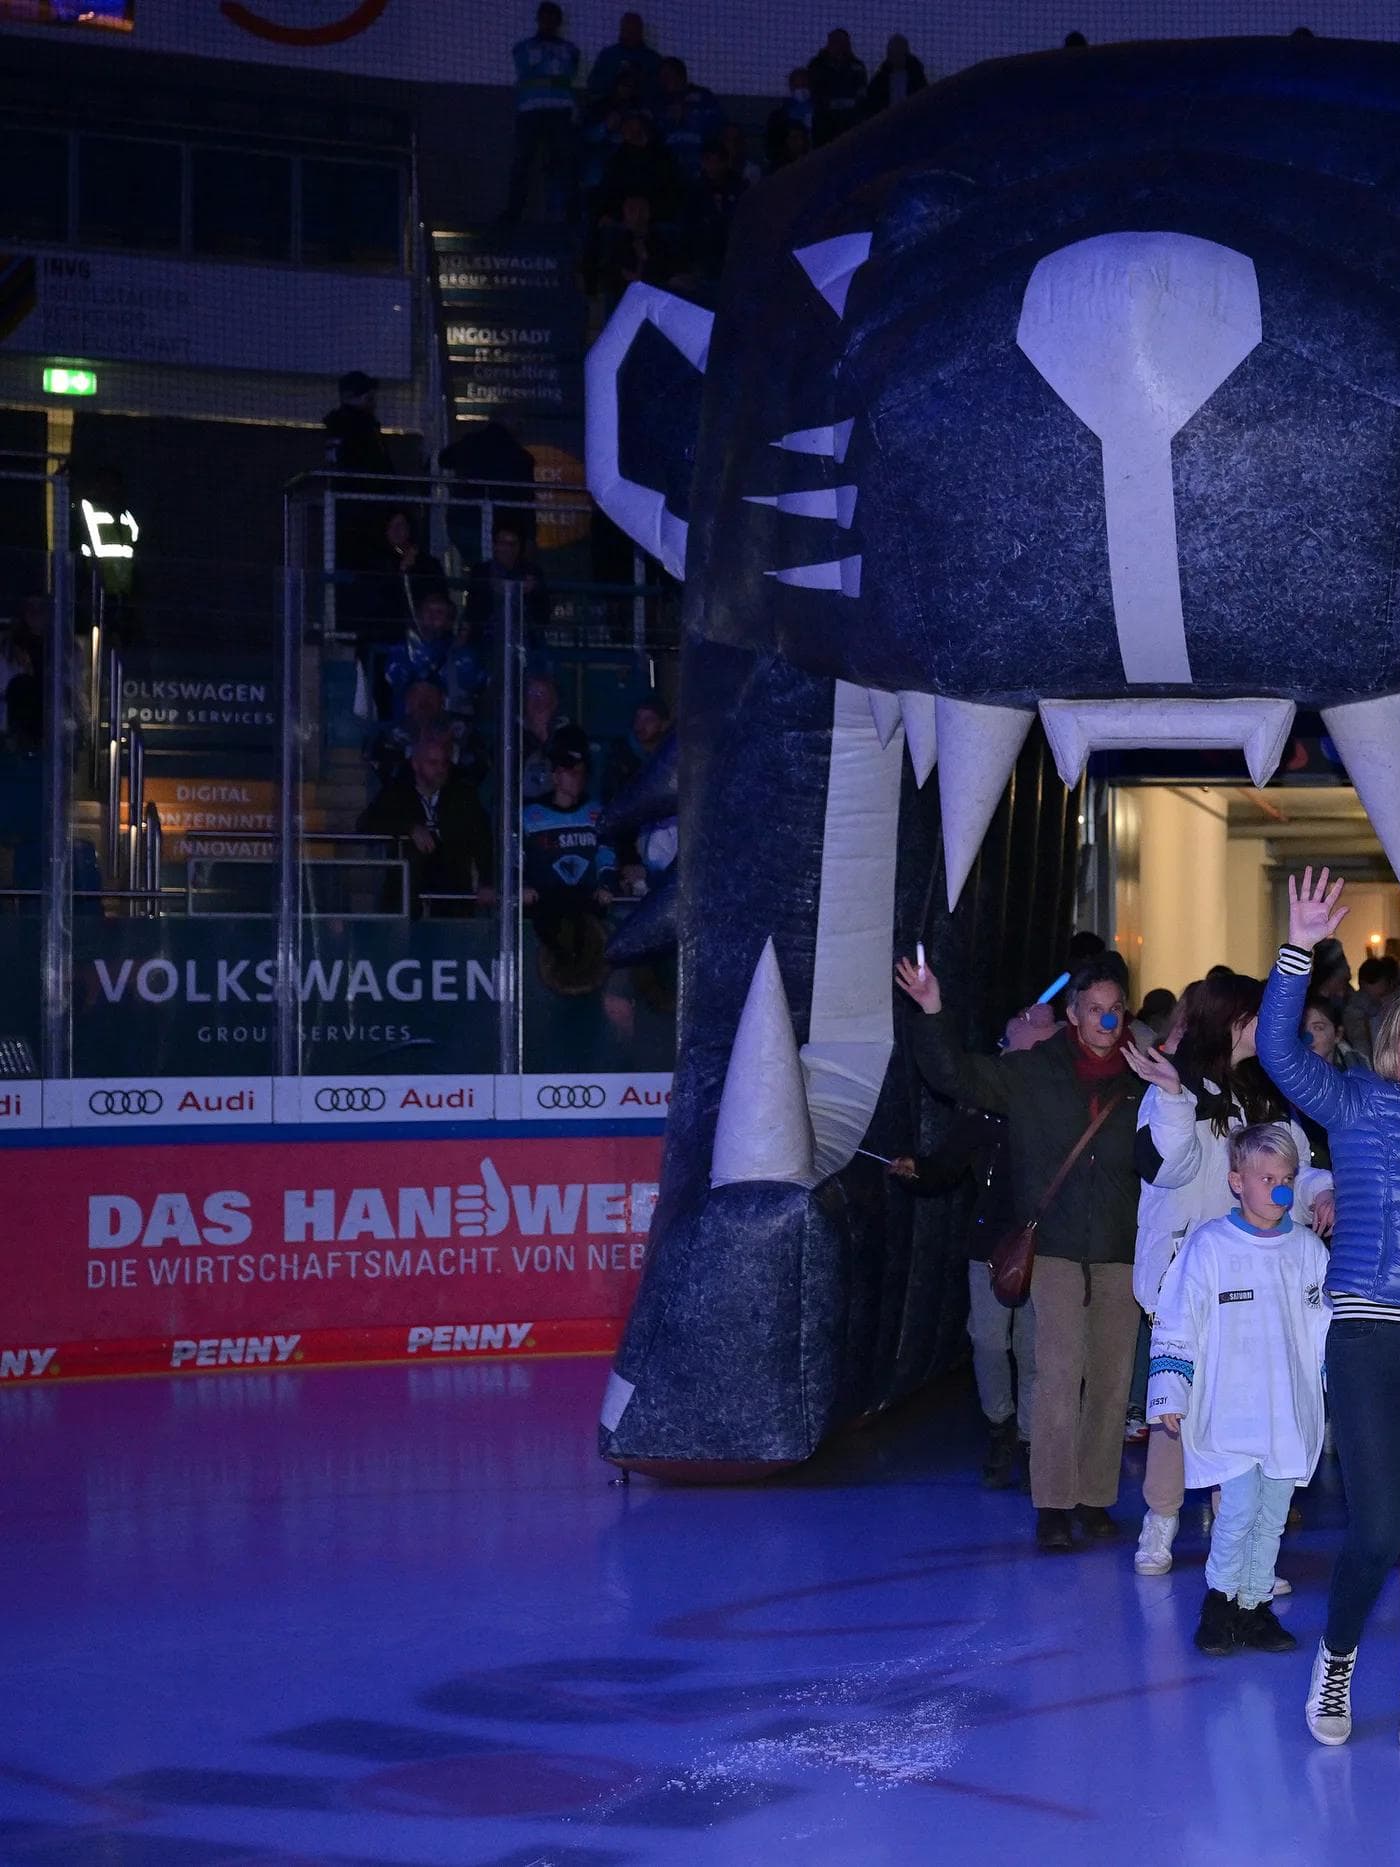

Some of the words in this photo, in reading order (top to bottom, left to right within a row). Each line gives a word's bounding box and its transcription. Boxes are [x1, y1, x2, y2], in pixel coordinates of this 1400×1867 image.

[439, 273, 488, 288] GROUP
[123, 680, 265, 702] OLKSWAGEN
[125, 707, 179, 722] ROUP
[187, 710, 275, 725] SERVICES
[176, 785, 252, 802] DIGITAL
[558, 831, 597, 848] SATUR
[93, 957, 502, 1003] VOLKSWAGEN
[197, 1025, 268, 1043] GROU
[0, 1094, 21, 1116] di
[178, 1089, 255, 1112] Audi
[400, 1087, 475, 1109] Audi
[620, 1086, 673, 1105] Au
[87, 1190, 252, 1249] DAS
[283, 1160, 660, 1243] HANDWE
[87, 1256, 137, 1289] DIE
[513, 1243, 575, 1274] VON
[588, 1242, 646, 1271] NEB
